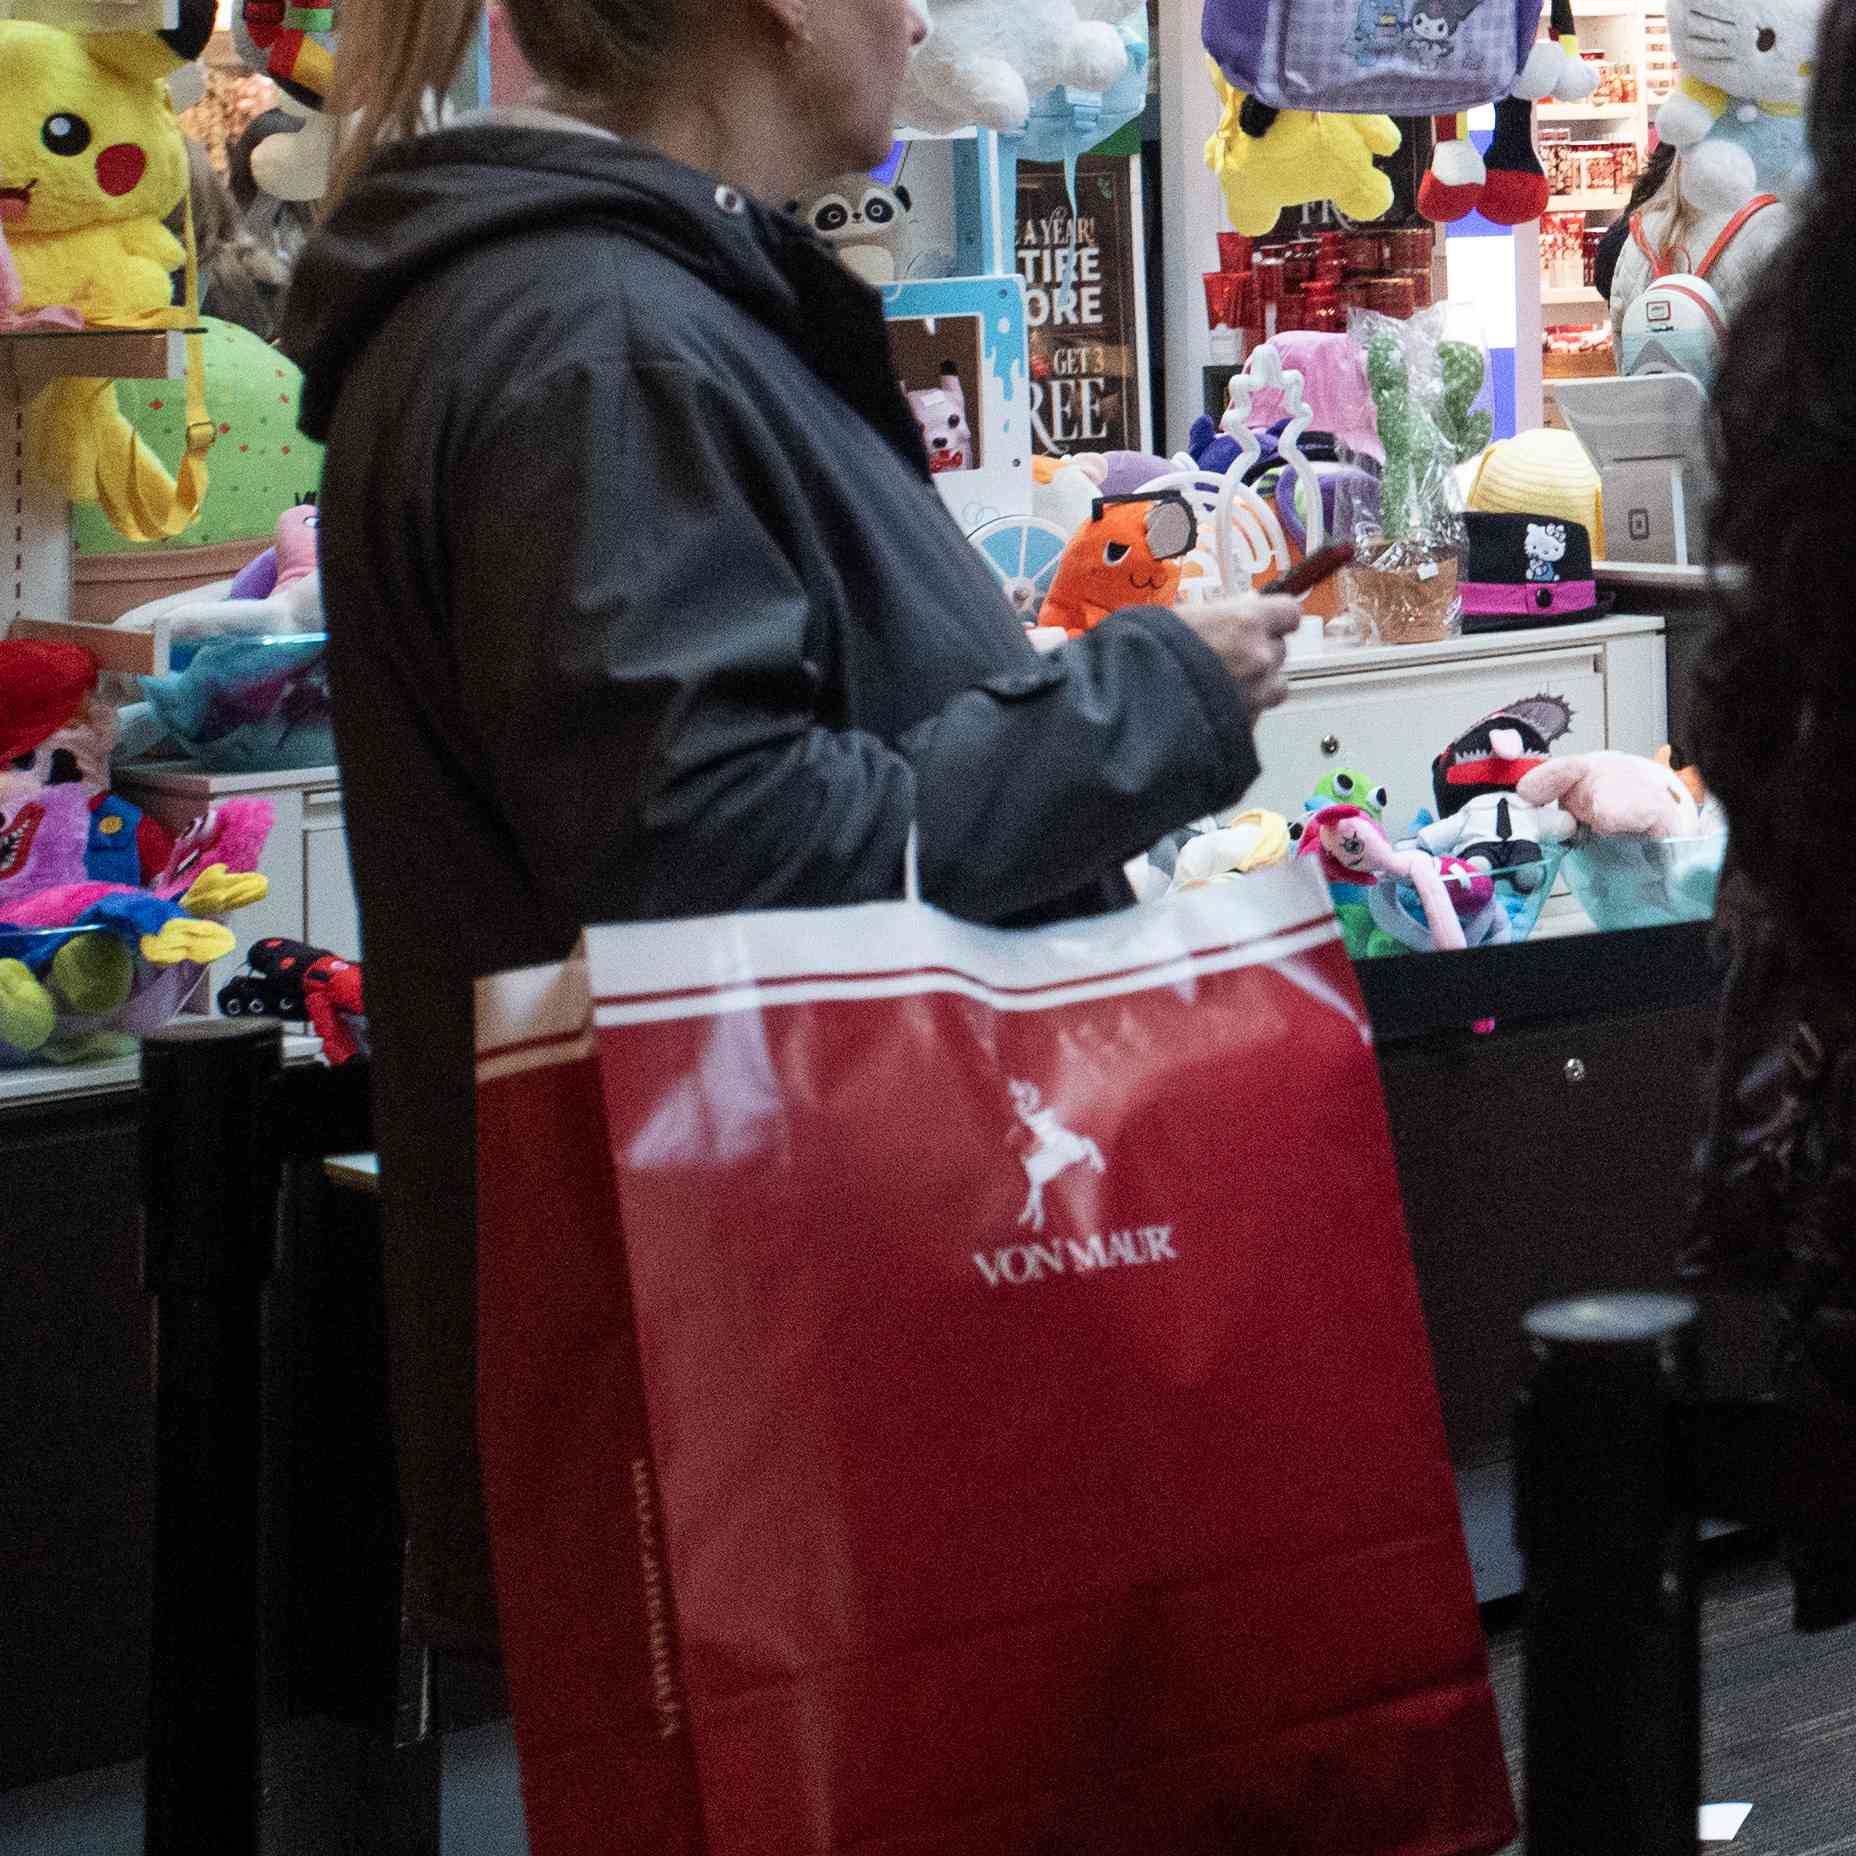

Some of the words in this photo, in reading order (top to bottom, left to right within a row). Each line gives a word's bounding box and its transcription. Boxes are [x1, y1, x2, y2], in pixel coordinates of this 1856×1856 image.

[1024, 218, 1038, 245] A
[1040, 206, 1097, 245] YEAR!
[1017, 245, 1102, 285] TIRE
[1027, 286, 1104, 327] ORE
[1053, 348, 1088, 377] GET
[1091, 346, 1105, 376] 3
[975, 1239, 1064, 1286] VON
[1067, 1225, 1178, 1274] MAUR
